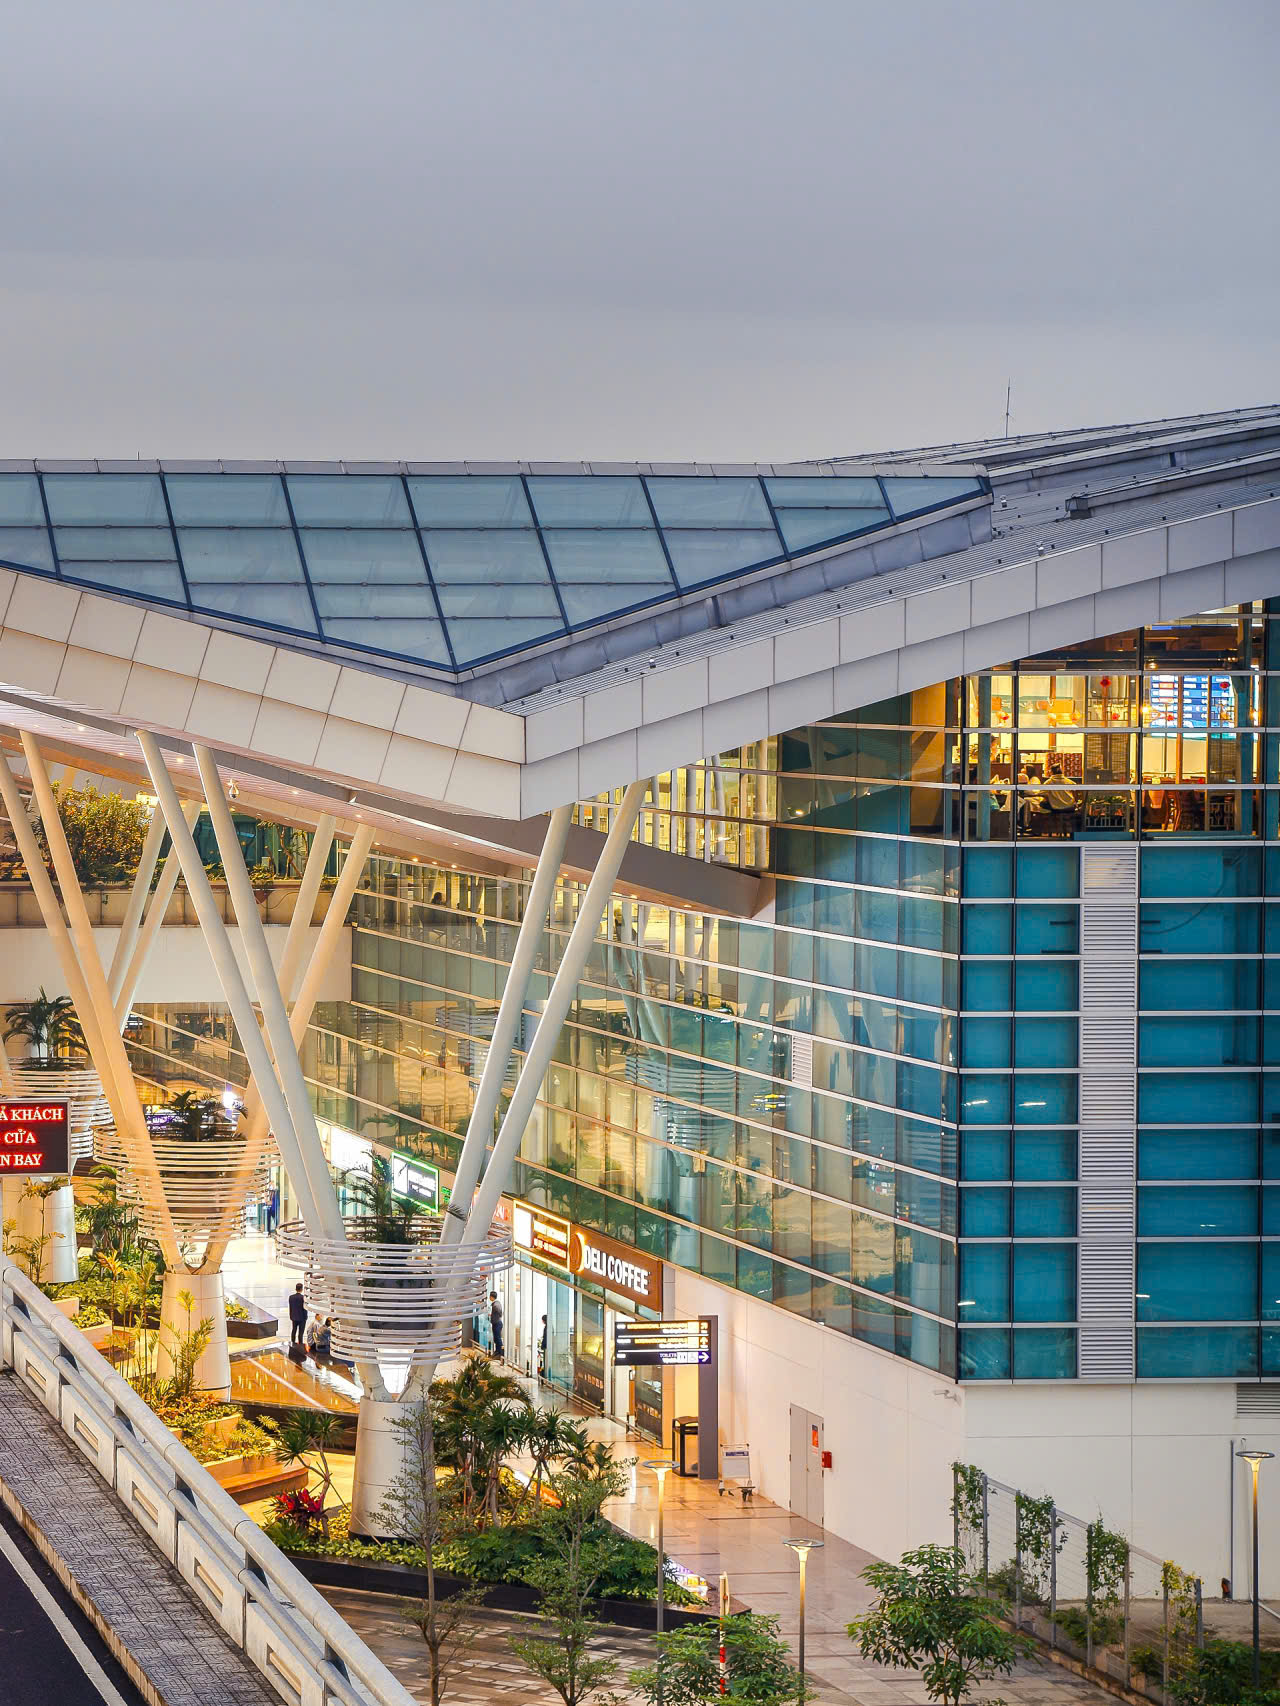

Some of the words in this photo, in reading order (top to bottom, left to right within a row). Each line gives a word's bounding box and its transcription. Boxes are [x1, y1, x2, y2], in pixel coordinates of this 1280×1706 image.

[10, 1106, 63, 1121] KHÁCH
[4, 1128, 36, 1144] CỬA
[13, 1153, 42, 1166] BAY
[583, 1244, 607, 1277] DELI
[607, 1255, 649, 1296] COFFEE
